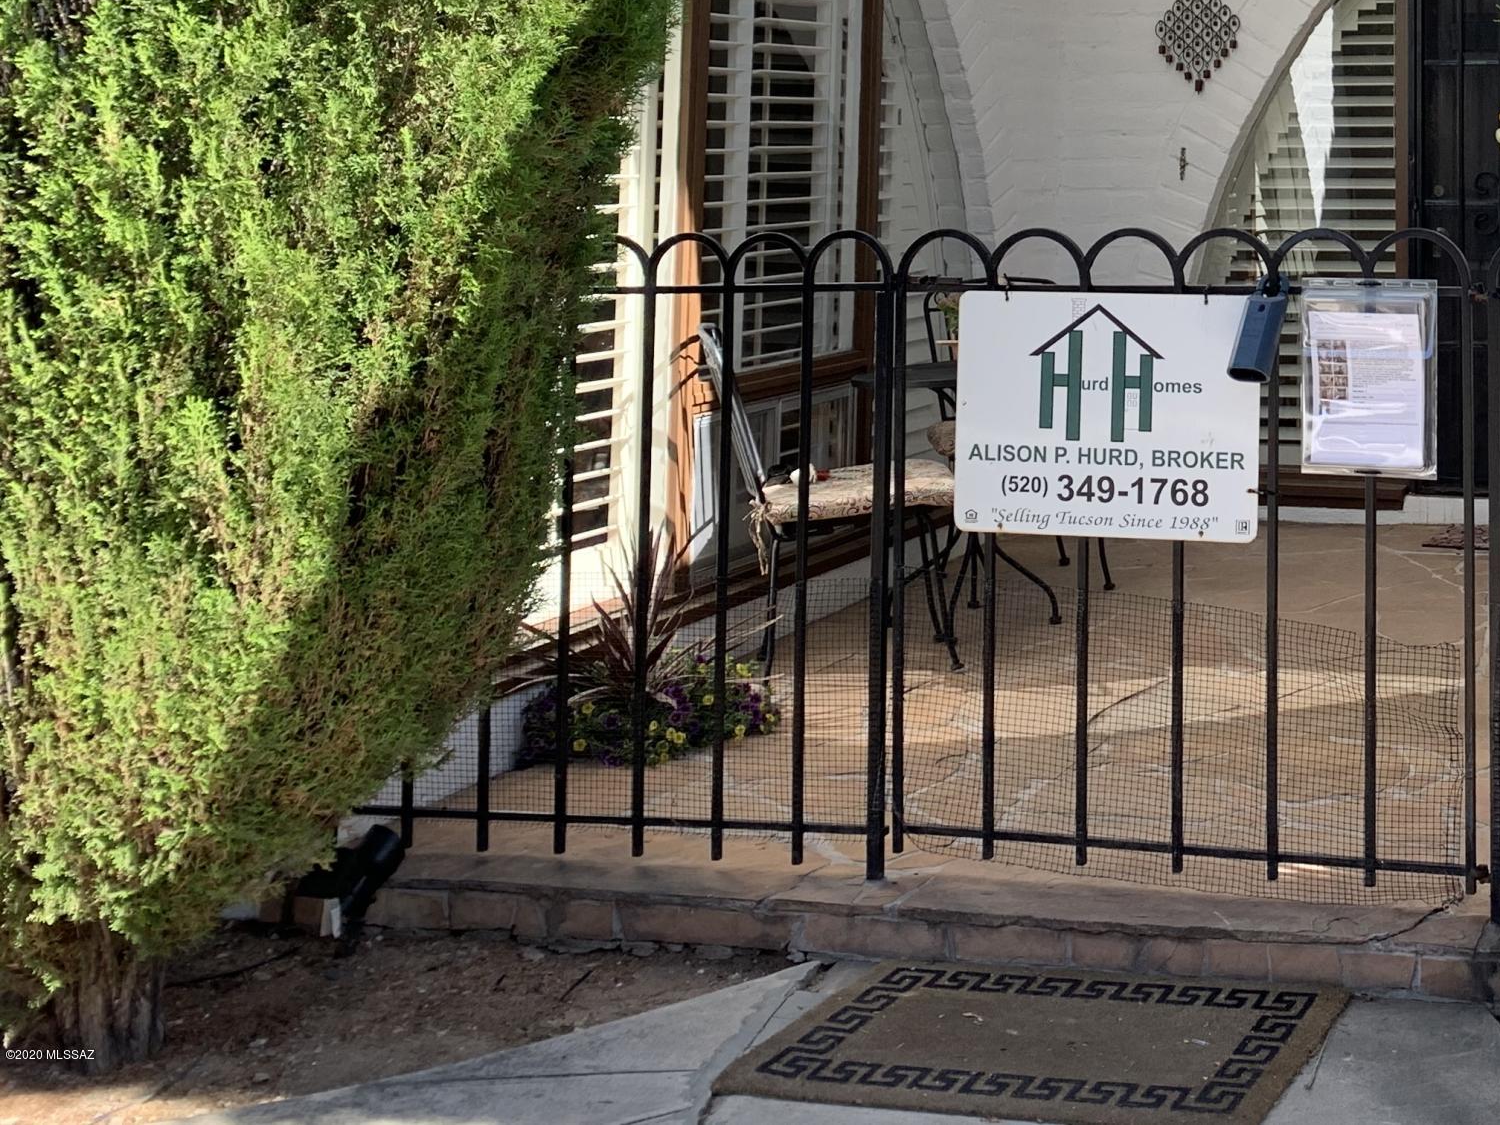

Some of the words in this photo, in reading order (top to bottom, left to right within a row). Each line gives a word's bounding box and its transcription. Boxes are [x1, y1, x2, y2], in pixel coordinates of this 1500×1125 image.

[968, 444, 1047, 463] ALISON
[1054, 447, 1070, 464] P.
[1078, 448, 1144, 469] HURD,
[1152, 450, 1245, 470] BROKER
[1001, 475, 1048, 498] (520)
[1057, 474, 1209, 507] 349-1768
[991, 507, 1051, 529] "Selling
[1055, 511, 1113, 527] Tucson
[1118, 513, 1163, 529] Since
[1170, 515, 1219, 531] 1988"
